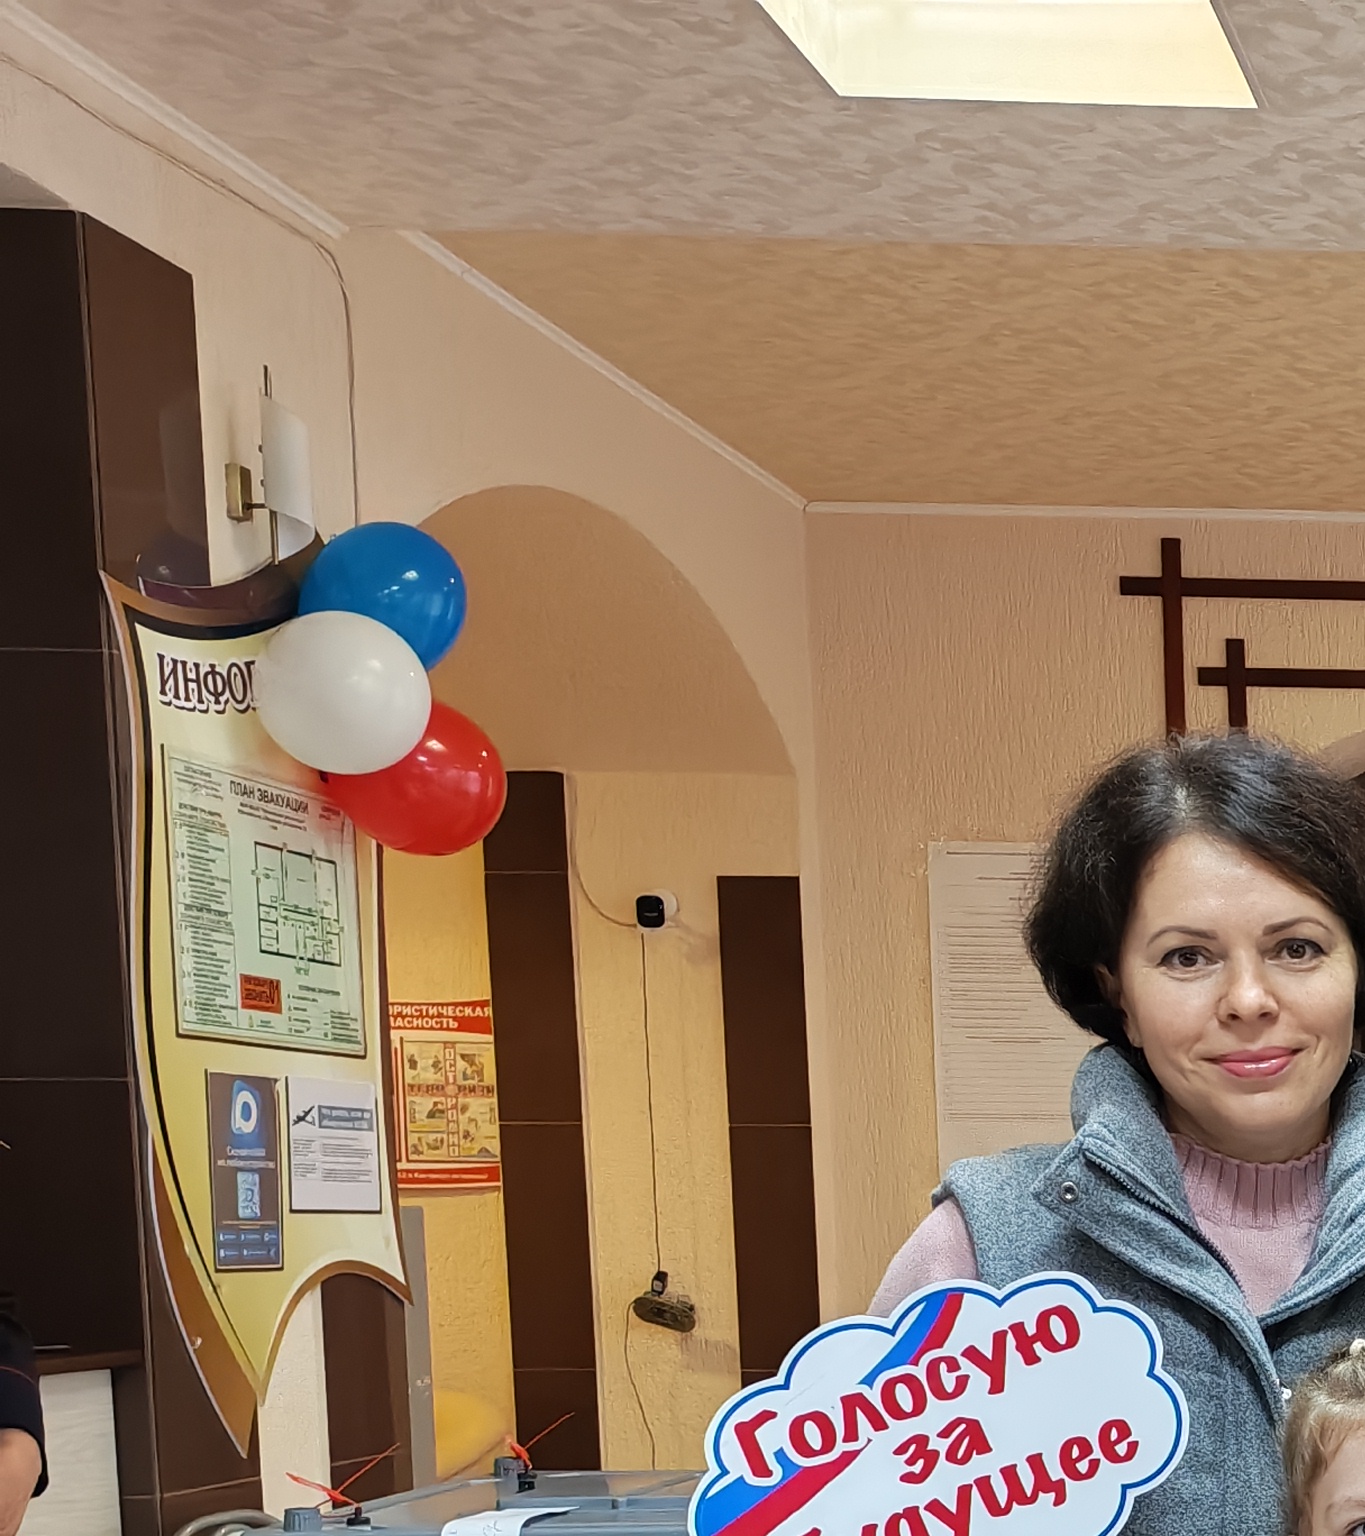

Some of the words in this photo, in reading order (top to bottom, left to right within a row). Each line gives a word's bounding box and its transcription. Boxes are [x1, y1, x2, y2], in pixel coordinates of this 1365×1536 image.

[230, 779, 255, 801] ПЛАН
[734, 1304, 1081, 1479] Голосую
[893, 1417, 993, 1485] за
